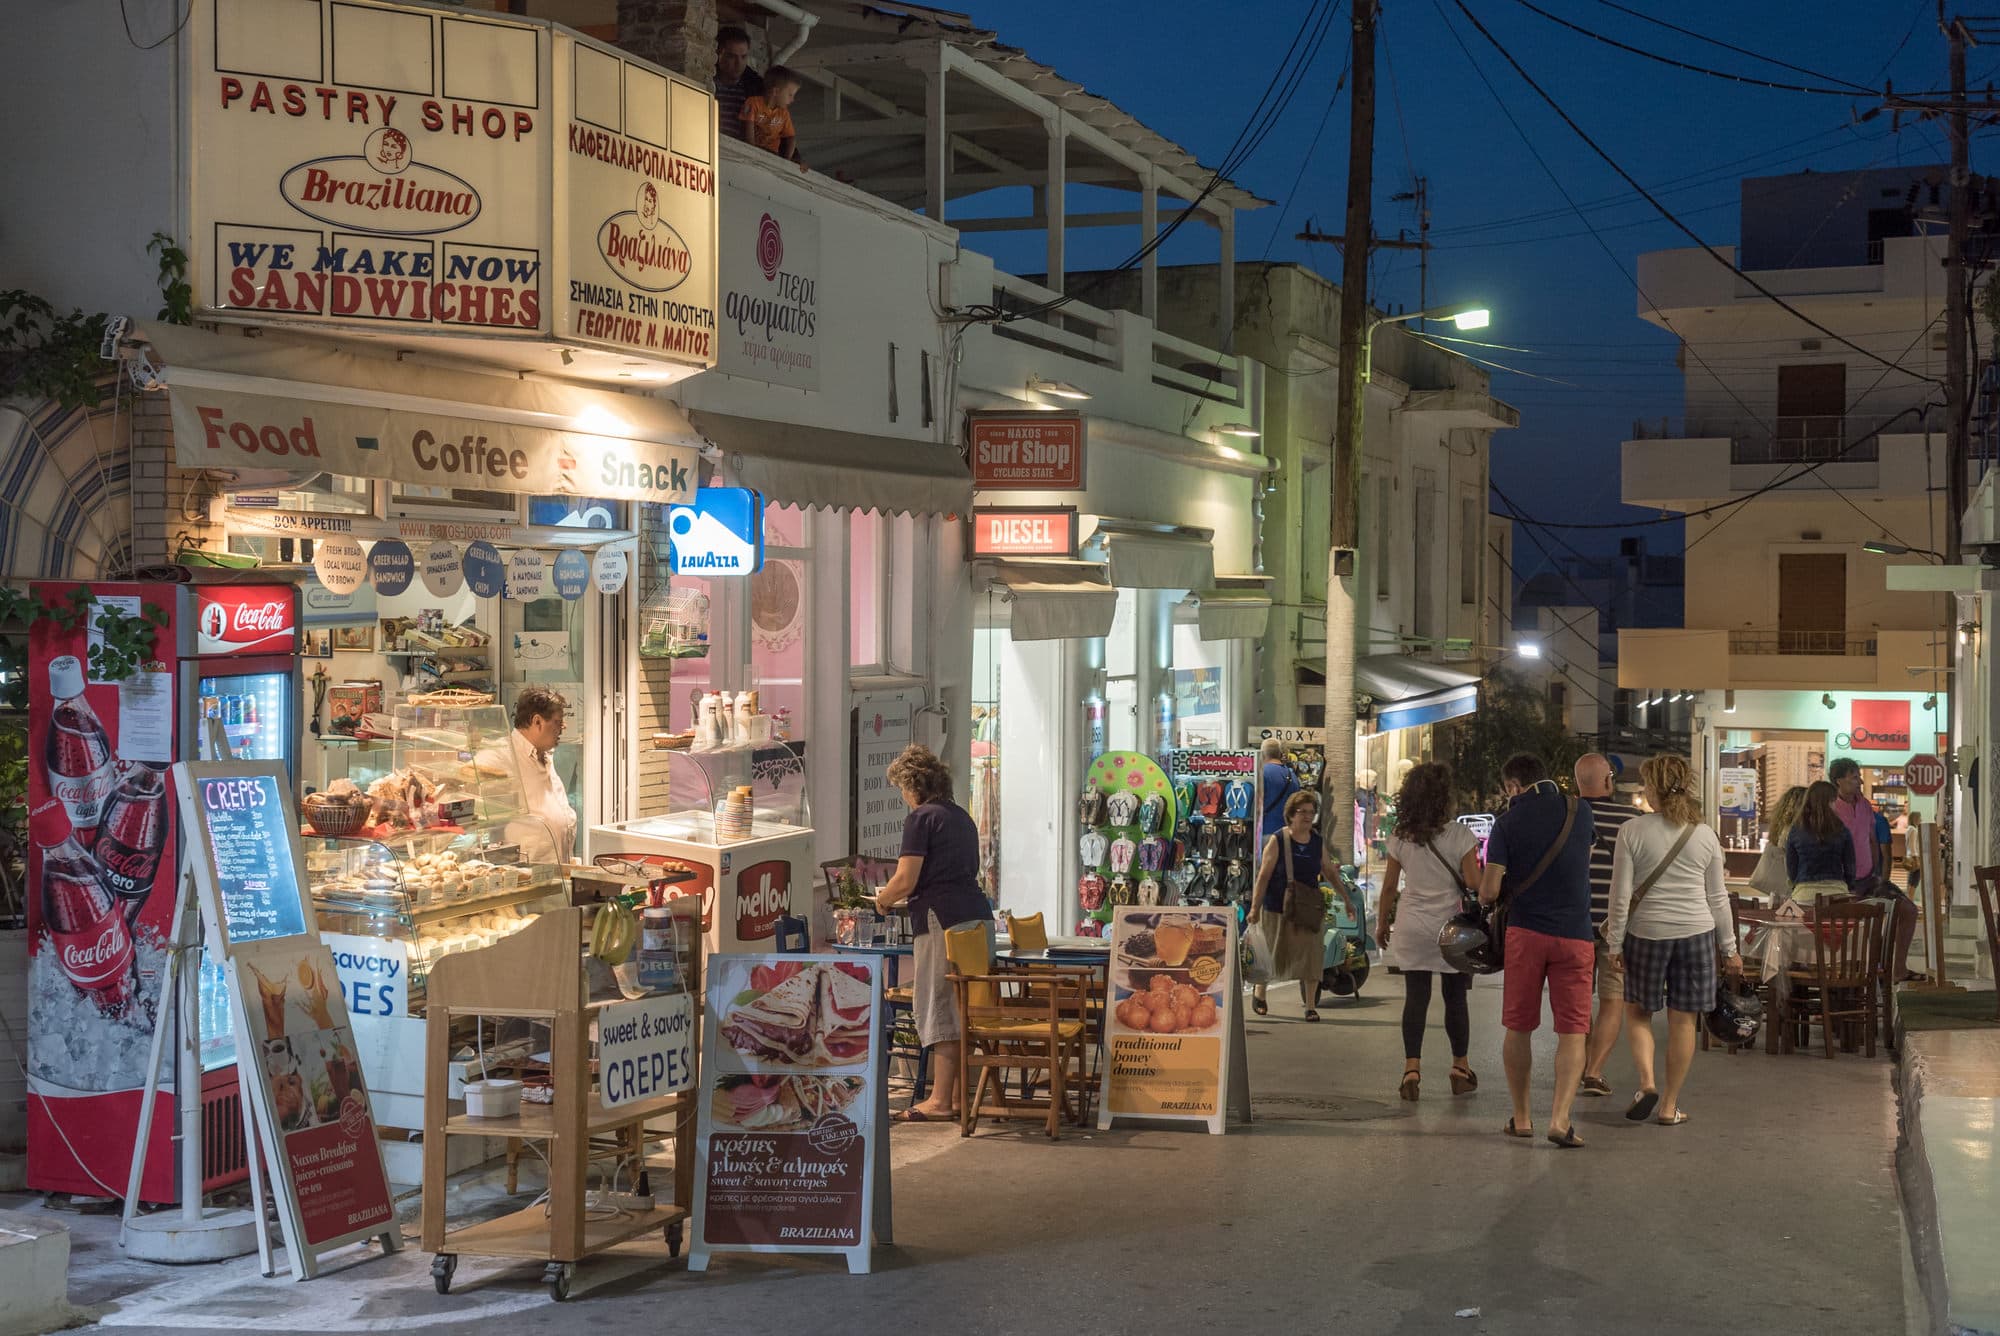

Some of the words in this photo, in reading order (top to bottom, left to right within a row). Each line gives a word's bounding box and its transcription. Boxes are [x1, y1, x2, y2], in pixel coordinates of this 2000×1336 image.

[221, 76, 397, 126] PASTRY
[421, 101, 533, 141] SHOP
[568, 122, 715, 197] ΚΑΦΕΖΑΧΑΡΟΠΛΑΣΤΕΙΟΝ
[301, 168, 473, 217] Braziliana
[607, 222, 688, 275] Βραζιλιάνα
[228, 241, 295, 270] WE
[312, 245, 434, 278] MAKE
[447, 255, 540, 284] NOW
[228, 267, 541, 328] SANDWICHES
[570, 280, 624, 312] ΣΗΜΑΣΙΑ
[628, 292, 659, 319] ΣΤΗΝ
[662, 300, 715, 330] ΠΟΙΟΤΗΤΑ
[577, 309, 642, 344] ΓΕΩΡΓΙΟΣ
[1007, 428, 1041, 439] NAXOS
[197, 406, 321, 457] Food
[412, 428, 529, 480] Coffee
[601, 450, 689, 493] Snack
[979, 440, 1019, 465] Surf
[1022, 440, 1070, 470] Shop
[993, 467, 1031, 478] CYCLADES
[1031, 467, 1055, 478] STATE
[274, 515, 297, 529] BON
[991, 519, 1053, 544] DIESEL
[324, 560, 340, 570] LOCAL
[341, 560, 361, 571] VILLAGE
[681, 551, 739, 568] LAVAZZA
[233, 602, 286, 631] Coca-Cola
[1276, 729, 1315, 742] ROXY
[864, 777, 883, 791] BODY
[1907, 764, 1943, 786] STOP
[206, 780, 267, 810] CREPES
[866, 799, 884, 814] BODY
[888, 798, 903, 810] OILS
[863, 824, 881, 838] BATH
[97, 837, 156, 878] Coca-Cola
[736, 872, 791, 921] mellow
[64, 918, 125, 969] Coca-Cola
[603, 1017, 638, 1047] sweet
[641, 1012, 651, 1039] &
[654, 1013, 691, 1037] savory
[1114, 1038, 1183, 1051] traditional
[607, 1046, 690, 1103] CREPES
[1112, 1064, 1157, 1077] donuts
[1160, 1101, 1213, 1111] BRAZILIANA
[292, 1152, 319, 1169] Naxos
[319, 1140, 357, 1160] Breakfast
[714, 1134, 777, 1157] κρέπες
[295, 1168, 316, 1186] juices
[711, 1156, 765, 1177] γλυκές
[766, 1156, 783, 1174] &
[783, 1156, 848, 1178] αλμυρές
[711, 1177, 741, 1187] sweet
[754, 1178, 791, 1191] savory
[792, 1178, 828, 1190] crepes
[348, 1203, 388, 1225] BRAZILIANA
[780, 1227, 855, 1240] BRAZILIANA
